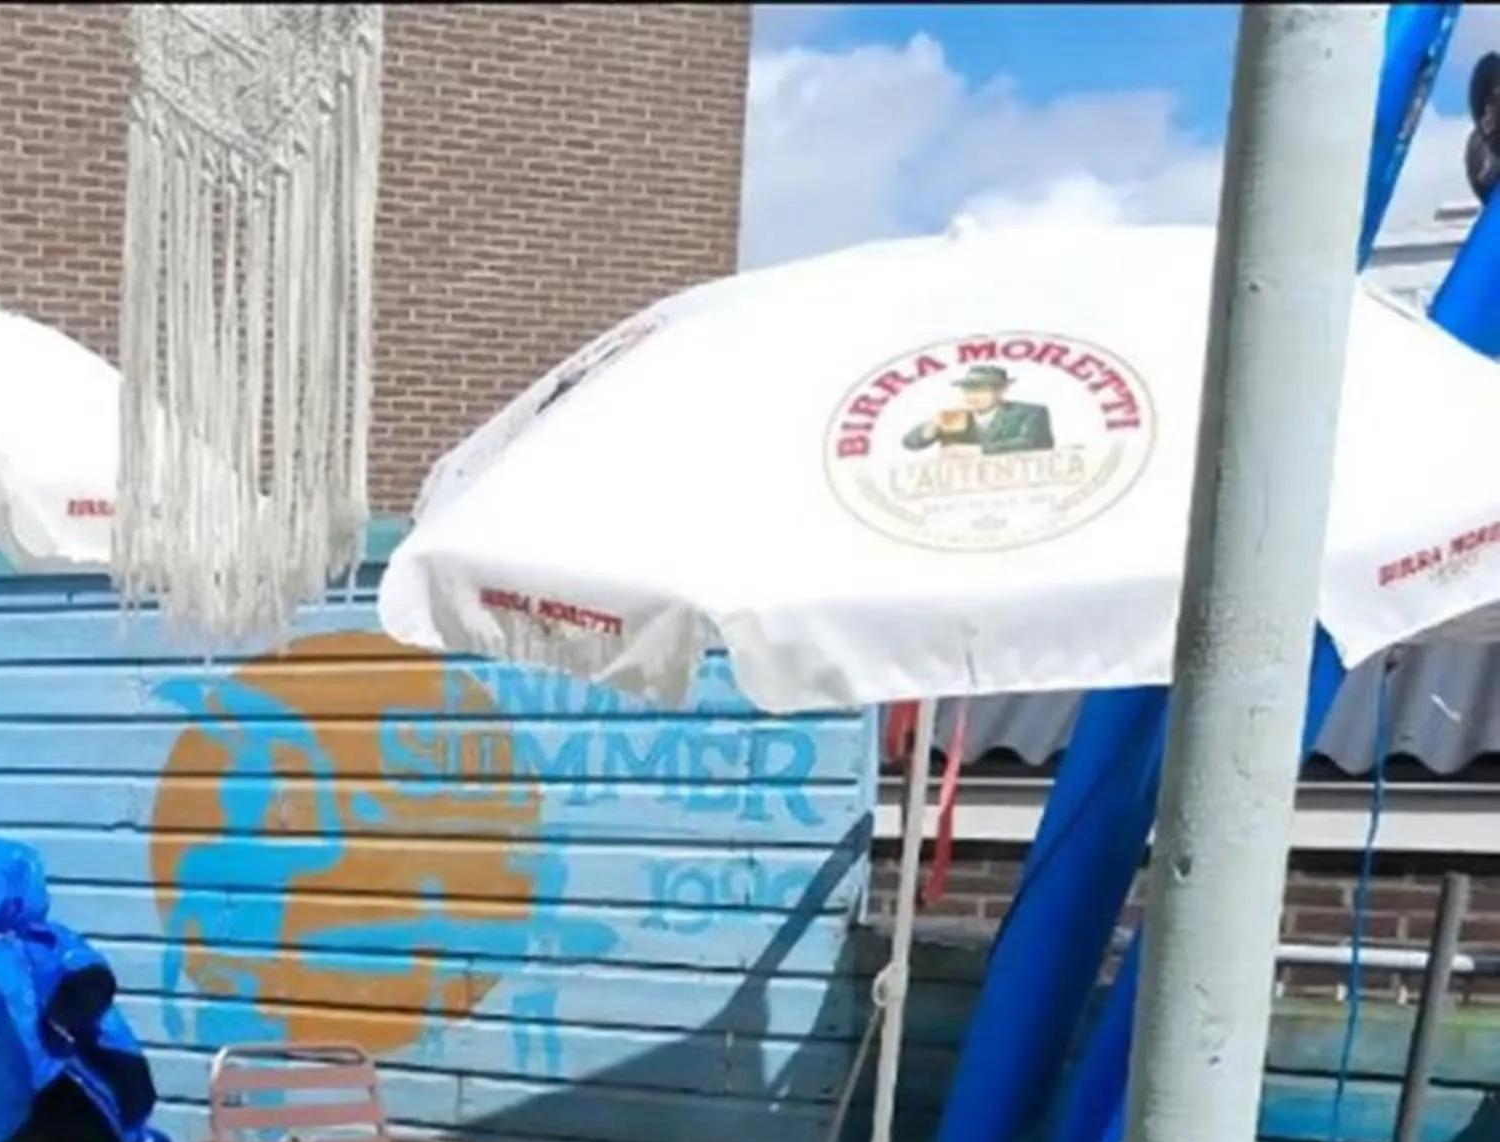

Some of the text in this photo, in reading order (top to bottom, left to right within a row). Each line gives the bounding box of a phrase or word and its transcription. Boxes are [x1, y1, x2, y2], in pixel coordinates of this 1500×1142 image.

[836, 338, 1142, 459] BIRRA MORETTI
[376, 707, 827, 827] SUMMER
